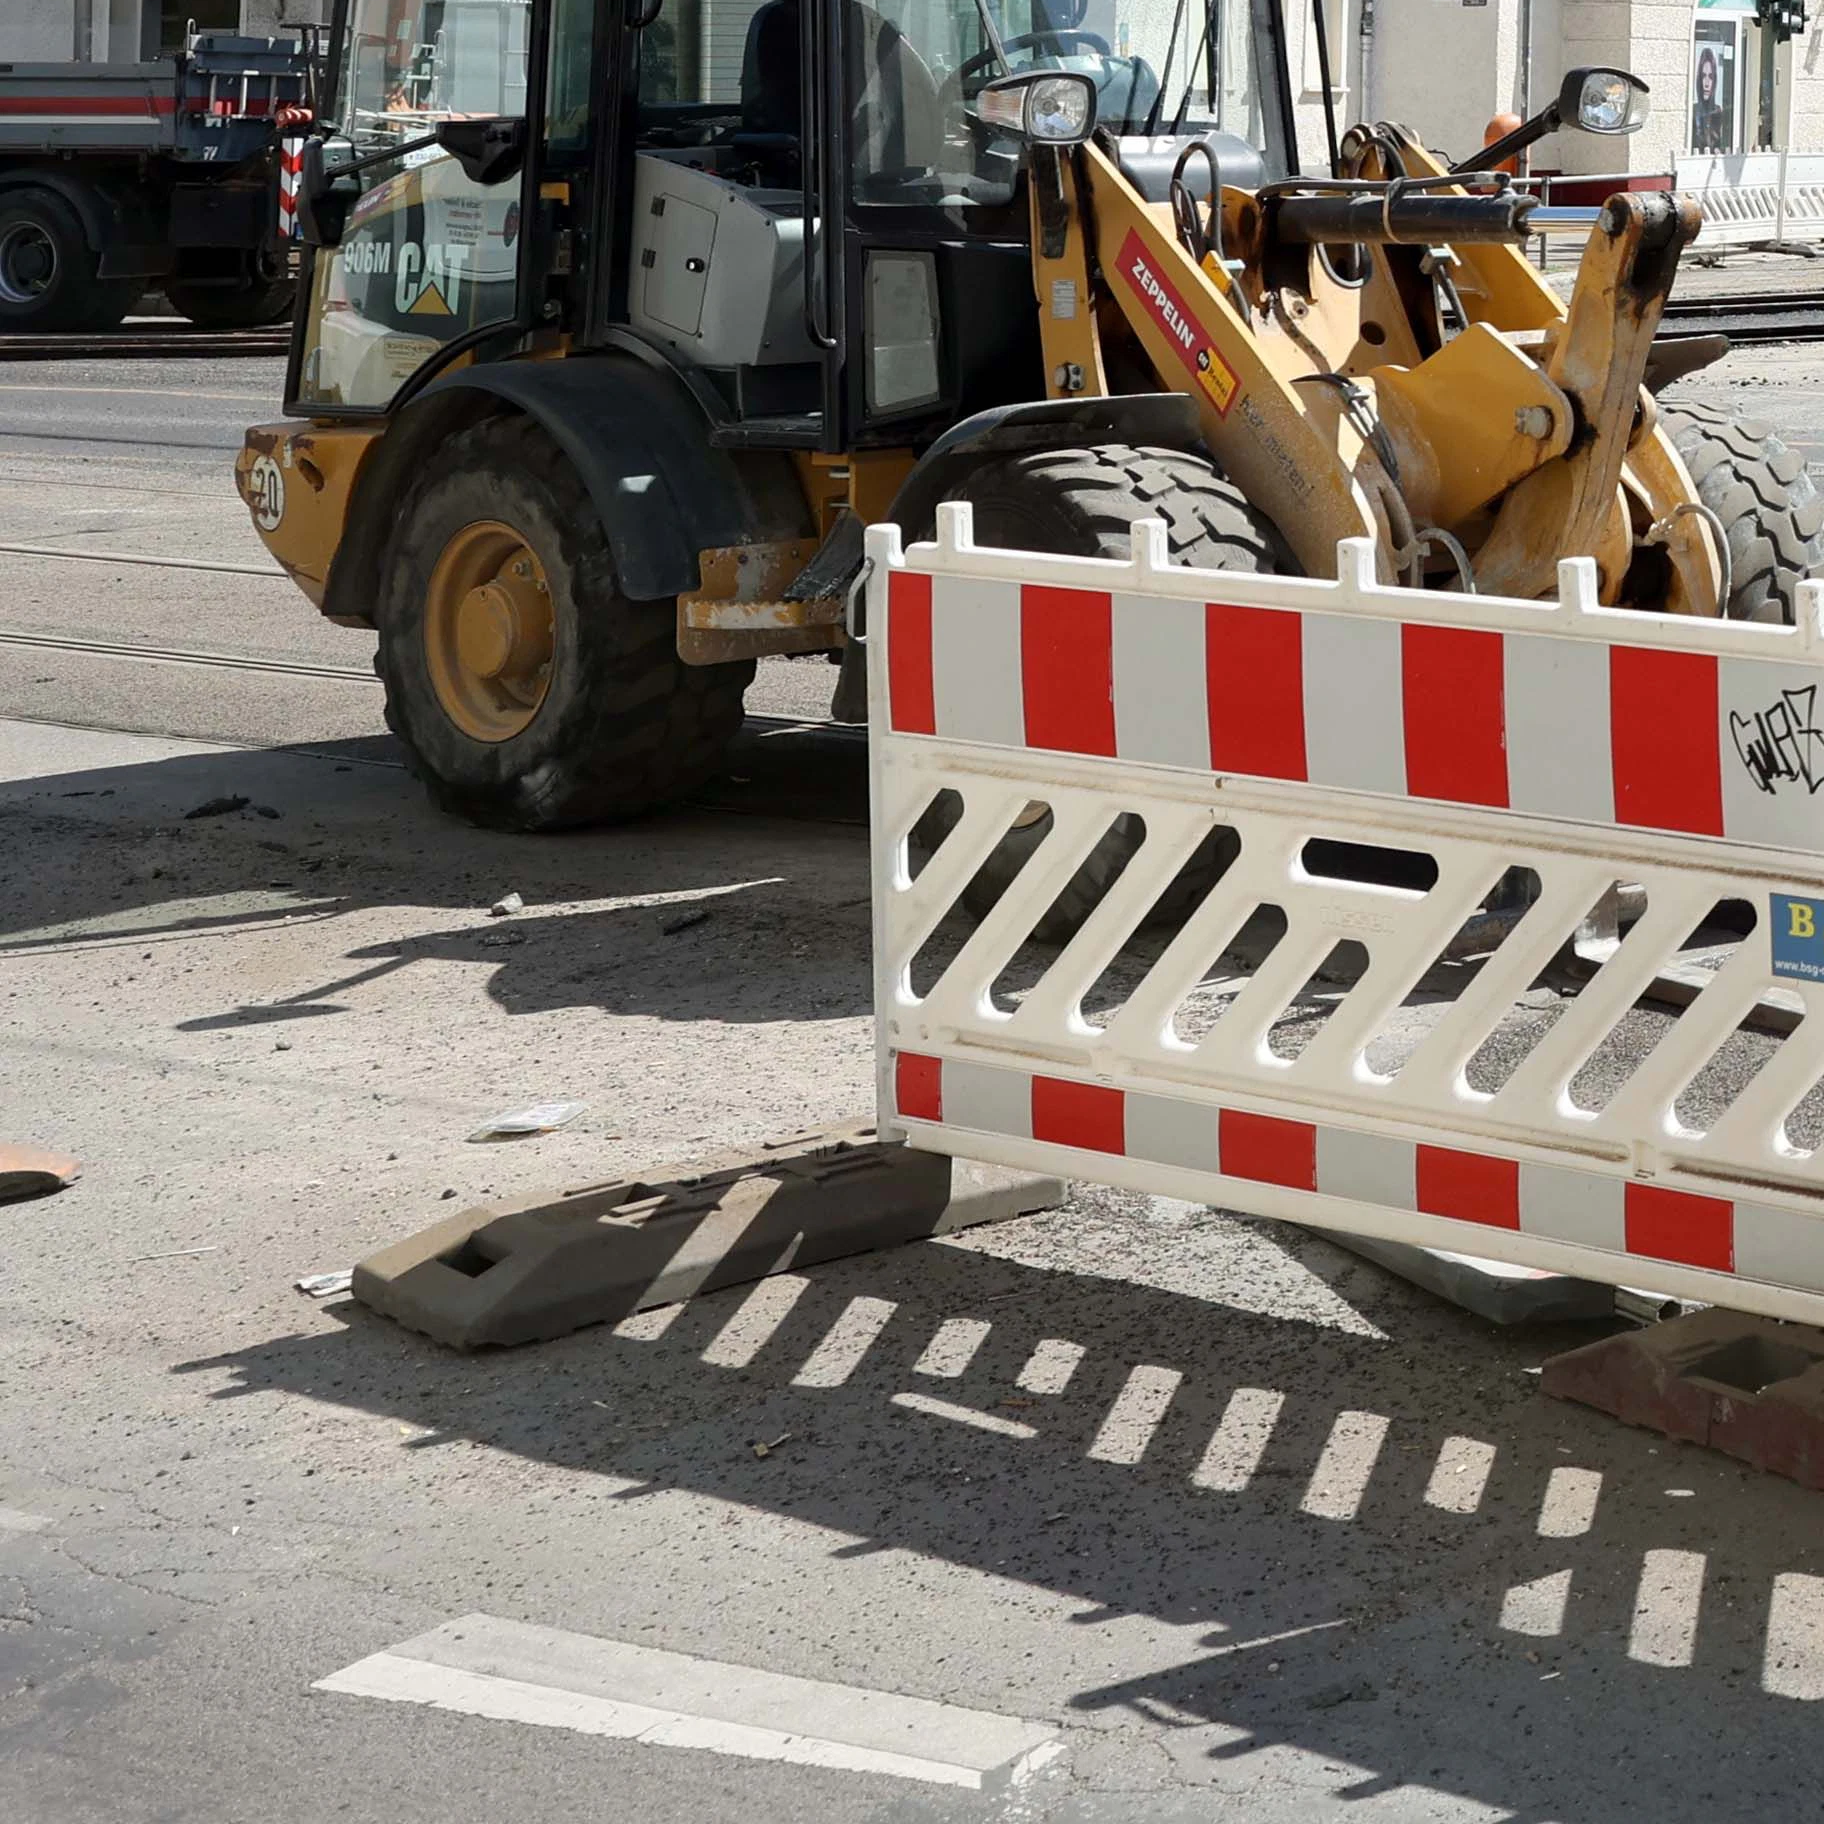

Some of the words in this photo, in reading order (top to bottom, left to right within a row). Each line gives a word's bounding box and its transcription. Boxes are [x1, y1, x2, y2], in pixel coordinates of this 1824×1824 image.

[344, 241, 391, 274] 906M
[394, 241, 470, 315] CAT
[1131, 257, 1195, 349] ZEPPELIN
[256, 467, 279, 517] 20
